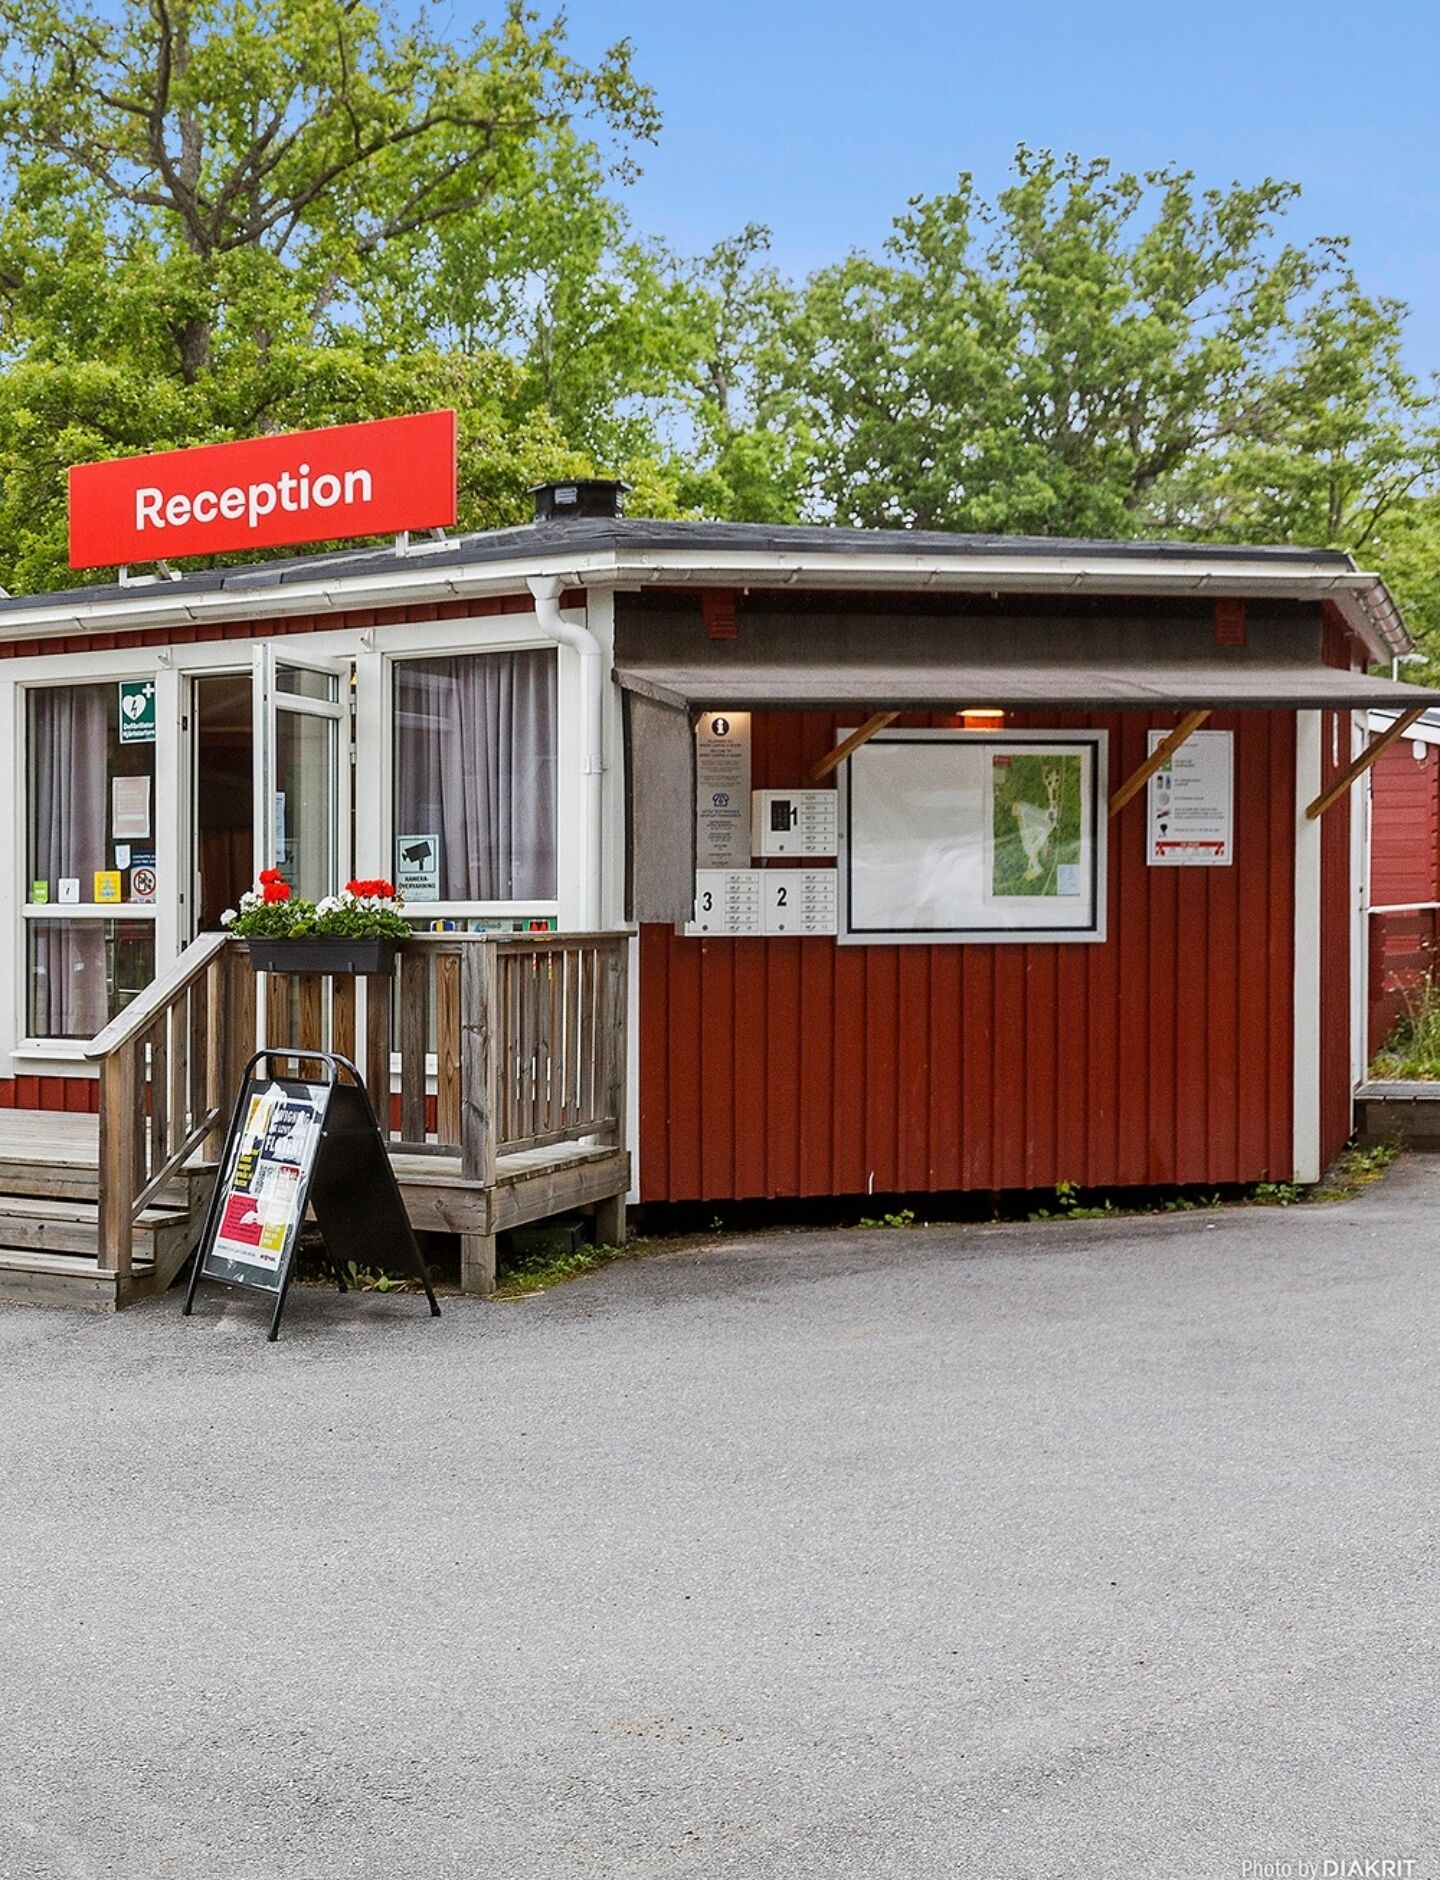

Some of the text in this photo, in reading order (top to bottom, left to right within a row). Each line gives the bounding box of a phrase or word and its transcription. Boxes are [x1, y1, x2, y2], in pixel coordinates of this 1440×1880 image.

[135, 463, 373, 531] Reception
[790, 806, 798, 826] 1
[702, 891, 713, 912] 3
[776, 887, 788, 907] 2
